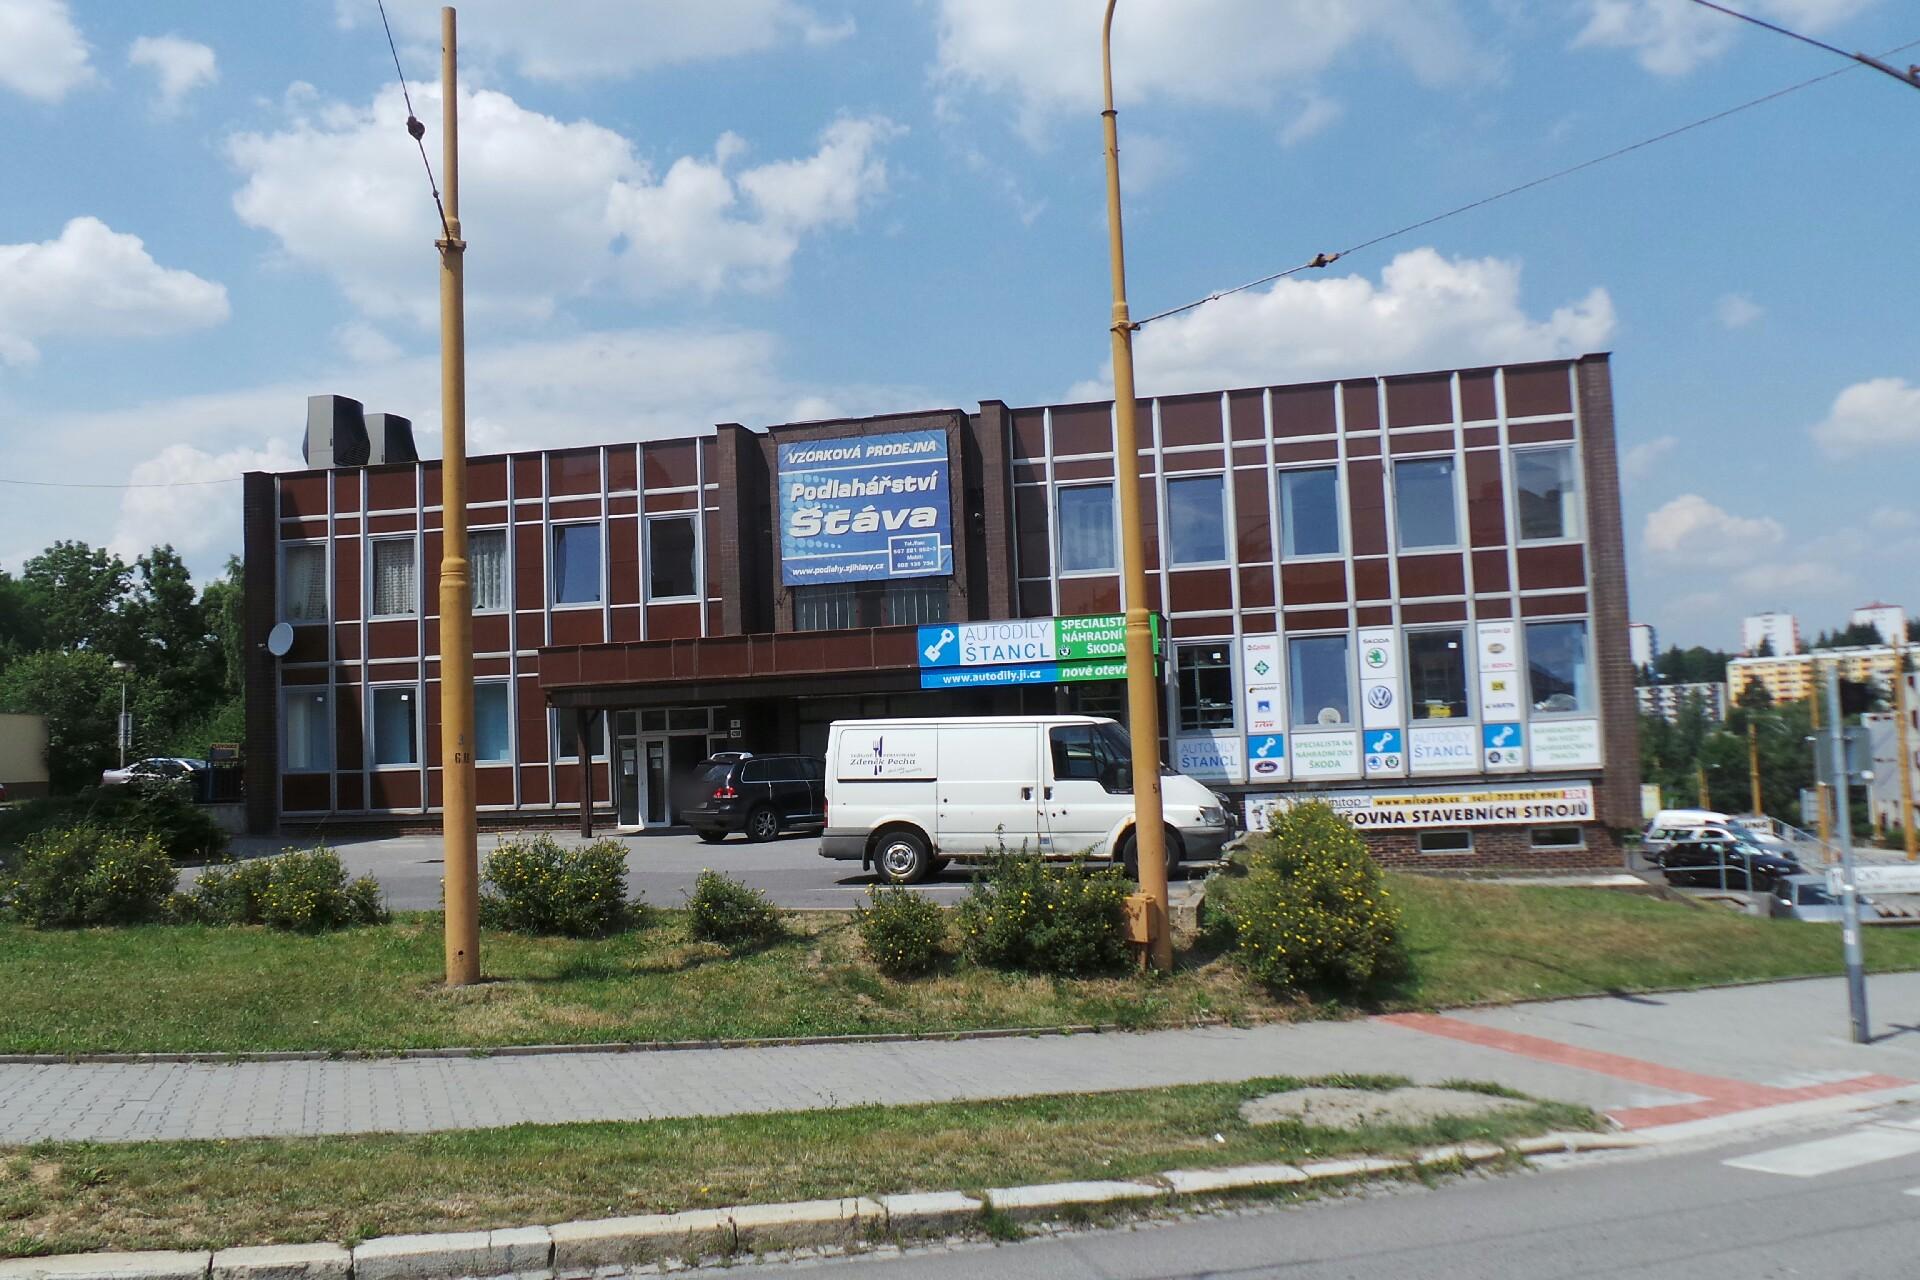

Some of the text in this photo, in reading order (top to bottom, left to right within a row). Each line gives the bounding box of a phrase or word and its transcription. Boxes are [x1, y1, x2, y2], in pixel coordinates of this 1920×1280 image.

[788, 440, 937, 464] VZORKOVÁ PRODEJNA
[790, 470, 939, 502] Podlahářství
[965, 620, 1049, 641] AUTODÍLY
[1062, 628, 1122, 643] NÁHRADNÍ
[966, 642, 1050, 662] ŠTANCL
[1087, 642, 1126, 654] ŠKODA
[942, 670, 1041, 684] www.autodily.ji.cz
[1062, 664, 1093, 677] nové
[1182, 754, 1238, 768] ŠTANCL
[1309, 758, 1341, 769] ŠKODA
[1412, 804, 1518, 822] STAVEBNÍCH
[1524, 802, 1590, 818] STROJŮ
